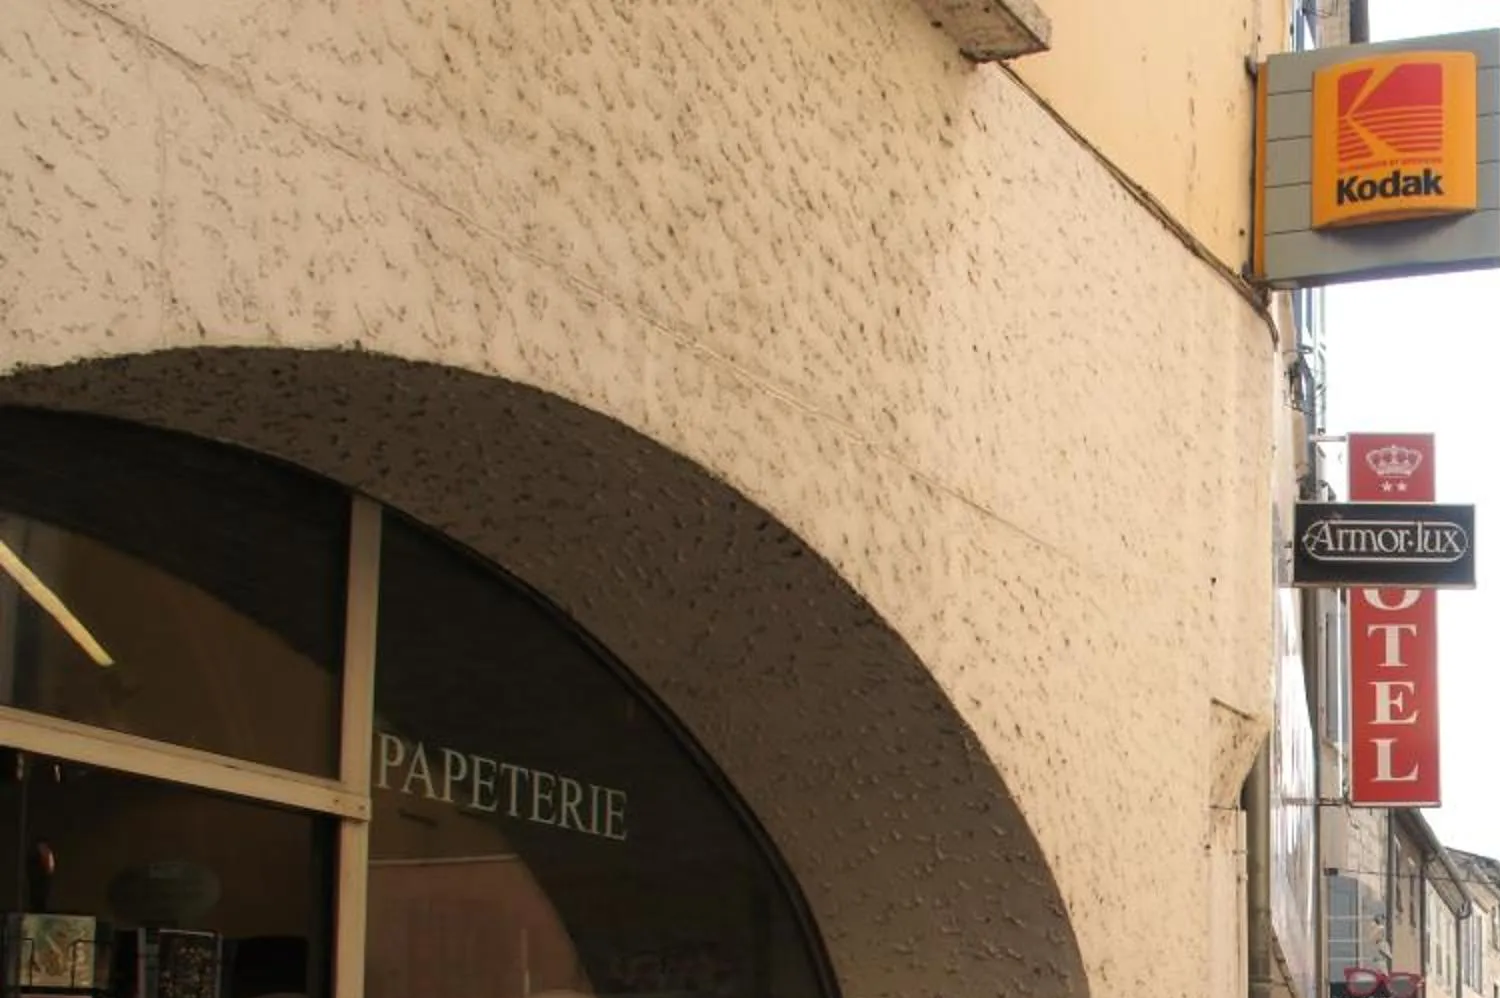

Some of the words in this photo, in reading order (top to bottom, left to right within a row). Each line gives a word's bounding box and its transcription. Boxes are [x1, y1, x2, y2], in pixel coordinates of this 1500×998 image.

[1336, 168, 1445, 206] Kodak
[1362, 588, 1420, 782] OTEL
[377, 731, 628, 841] PAPETERIE
